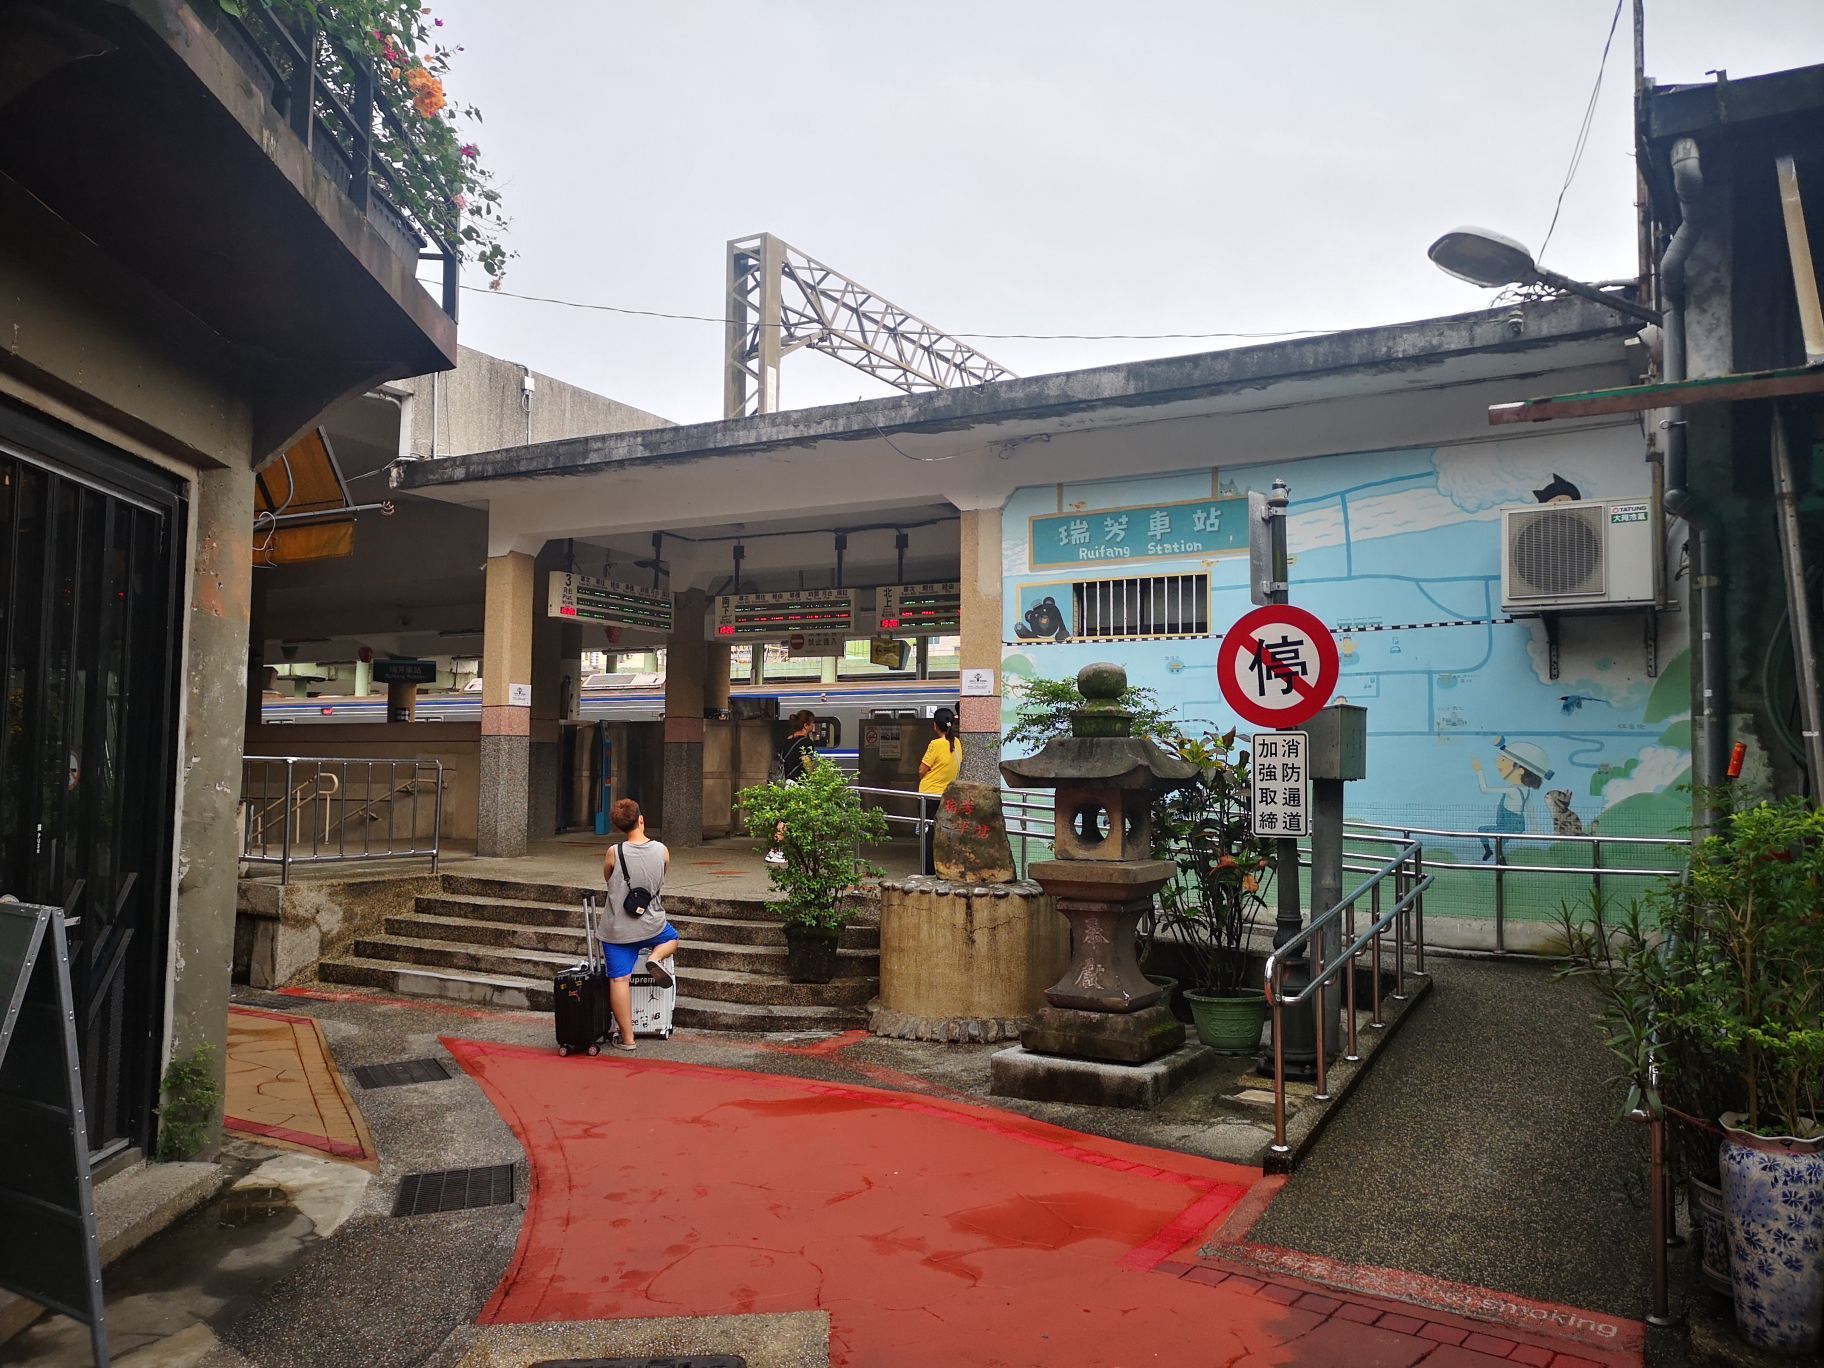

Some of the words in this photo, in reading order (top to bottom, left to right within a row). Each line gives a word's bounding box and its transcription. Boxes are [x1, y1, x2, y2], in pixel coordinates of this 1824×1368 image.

[1059, 507, 1221, 546] 瑞芳車站
[1079, 546, 1130, 560] Ruifang
[1147, 540, 1202, 554] Station
[565, 574, 571, 586] 3
[1248, 635, 1308, 697] 停
[1258, 738, 1279, 831] 加強取締
[1281, 738, 1302, 832] 消防通道
[631, 976, 656, 985] uprem
[1481, 1297, 1618, 1338] smoking
